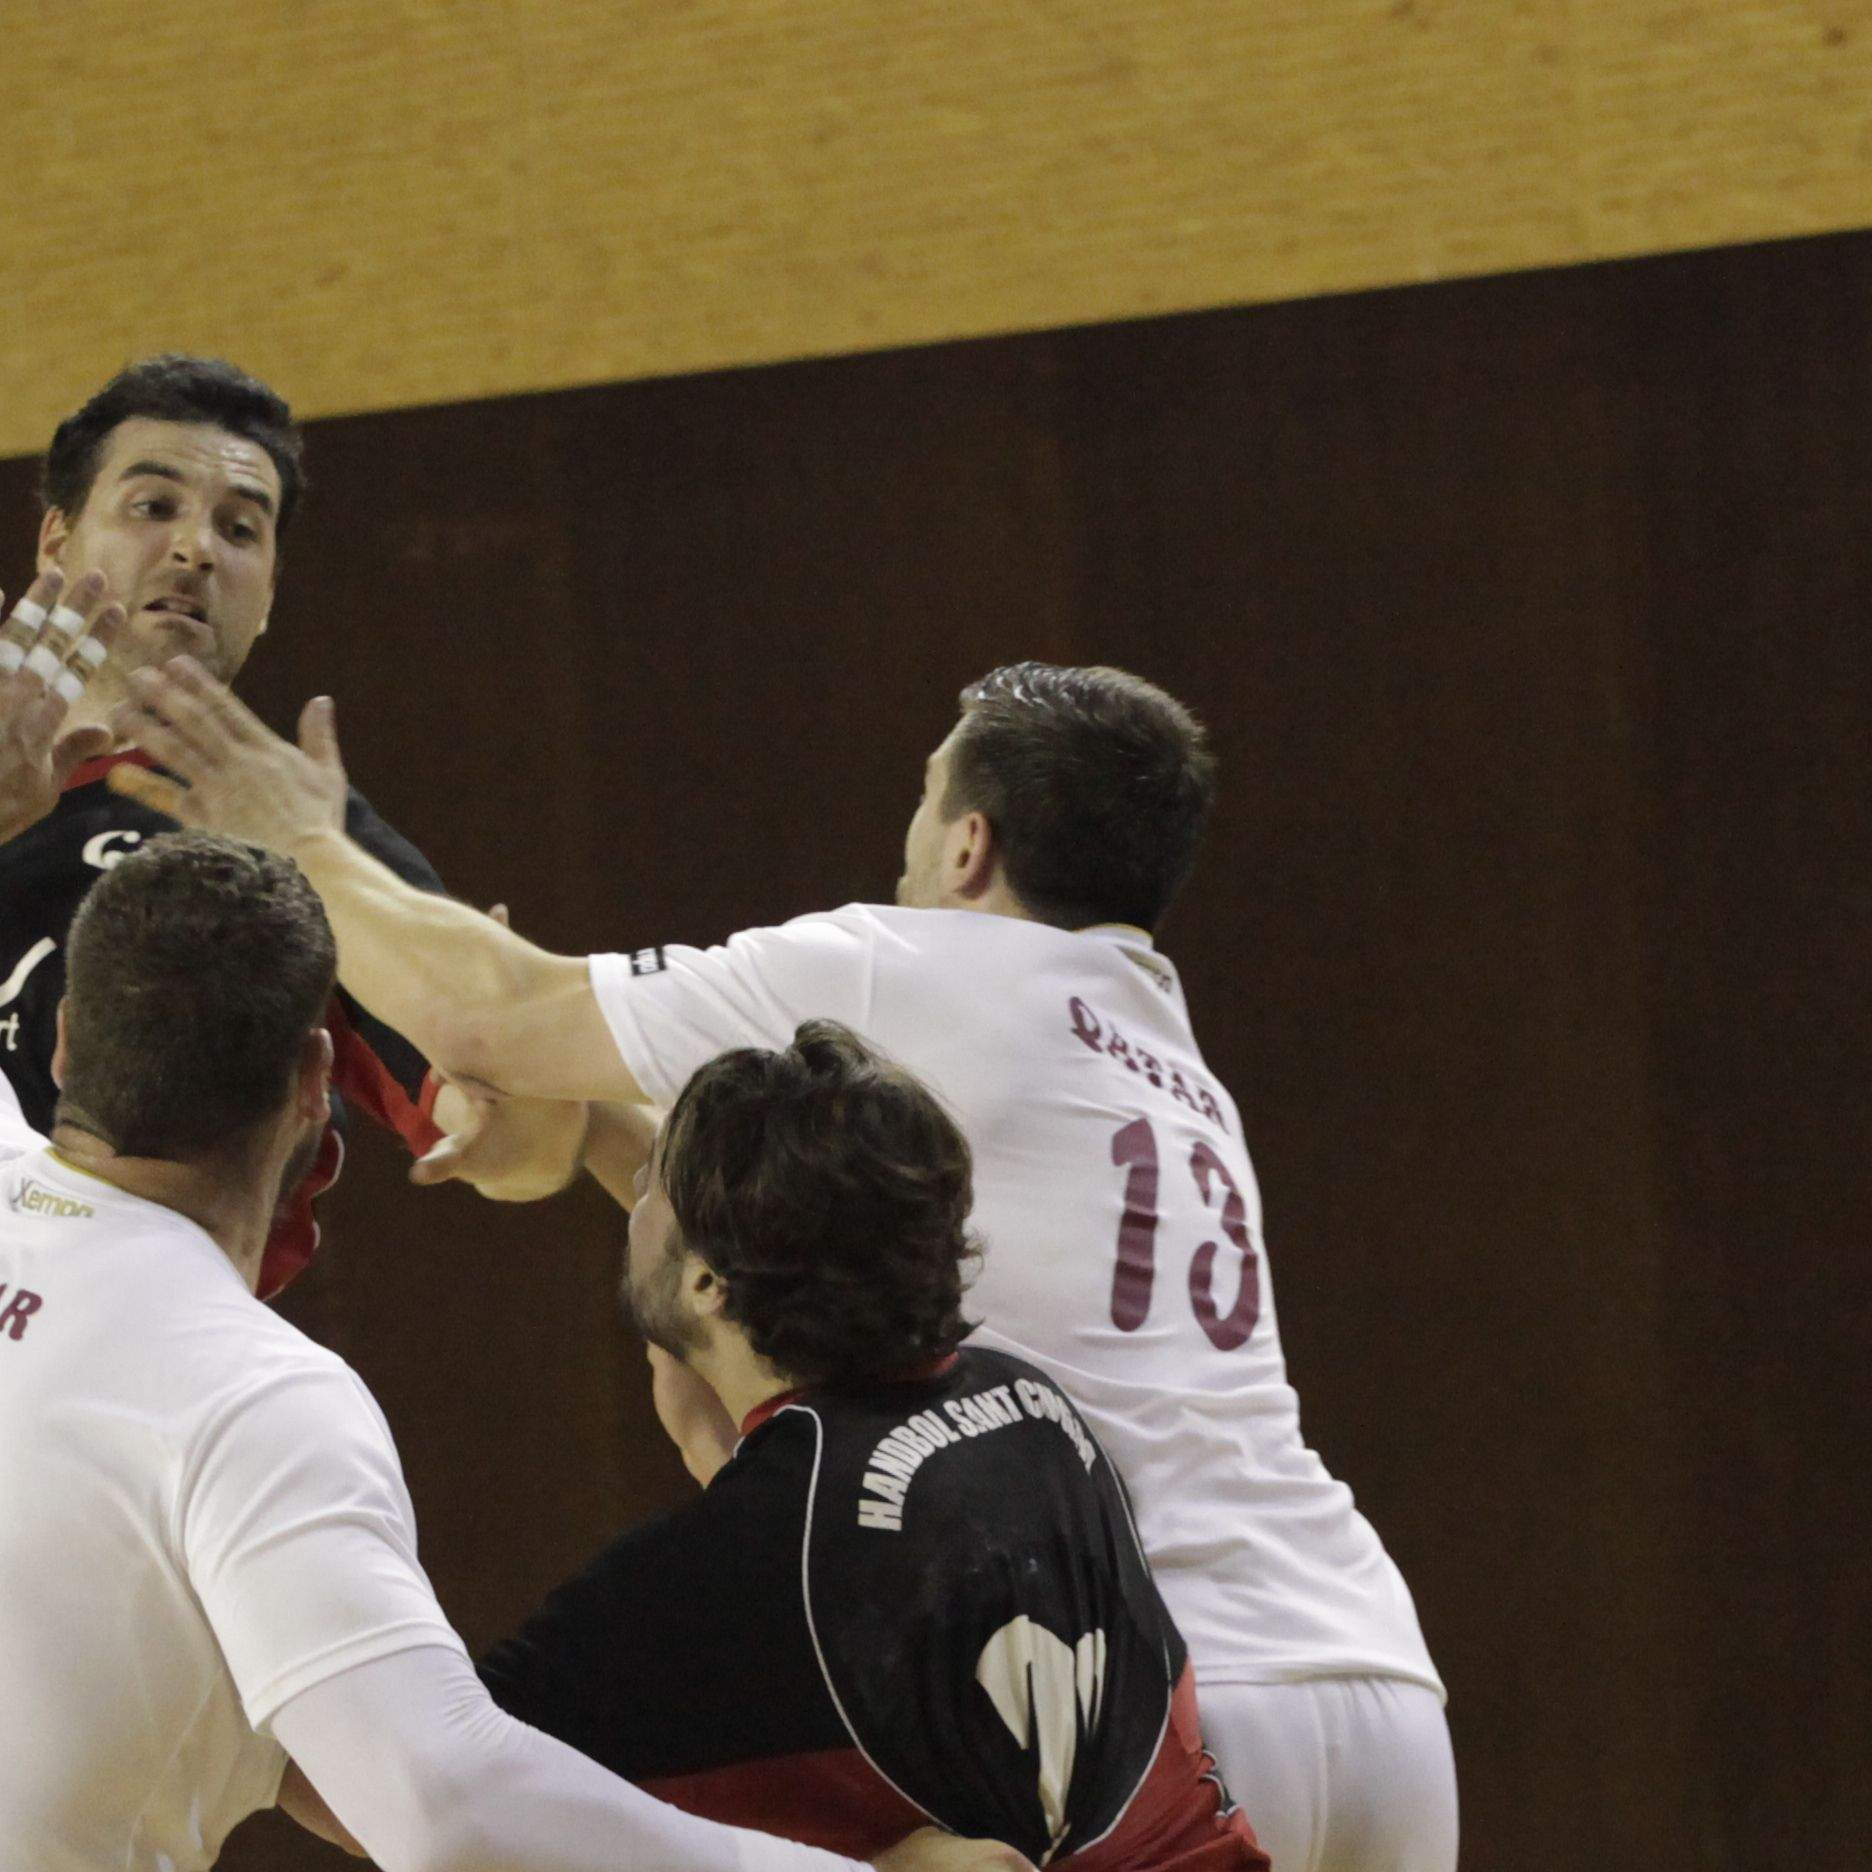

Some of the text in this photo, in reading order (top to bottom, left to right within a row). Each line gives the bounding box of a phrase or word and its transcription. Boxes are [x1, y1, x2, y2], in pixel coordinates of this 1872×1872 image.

[1111, 1117, 1259, 1351] 13
[857, 1409, 962, 1531] HANDBOL
[943, 1385, 1024, 1438] SANT
